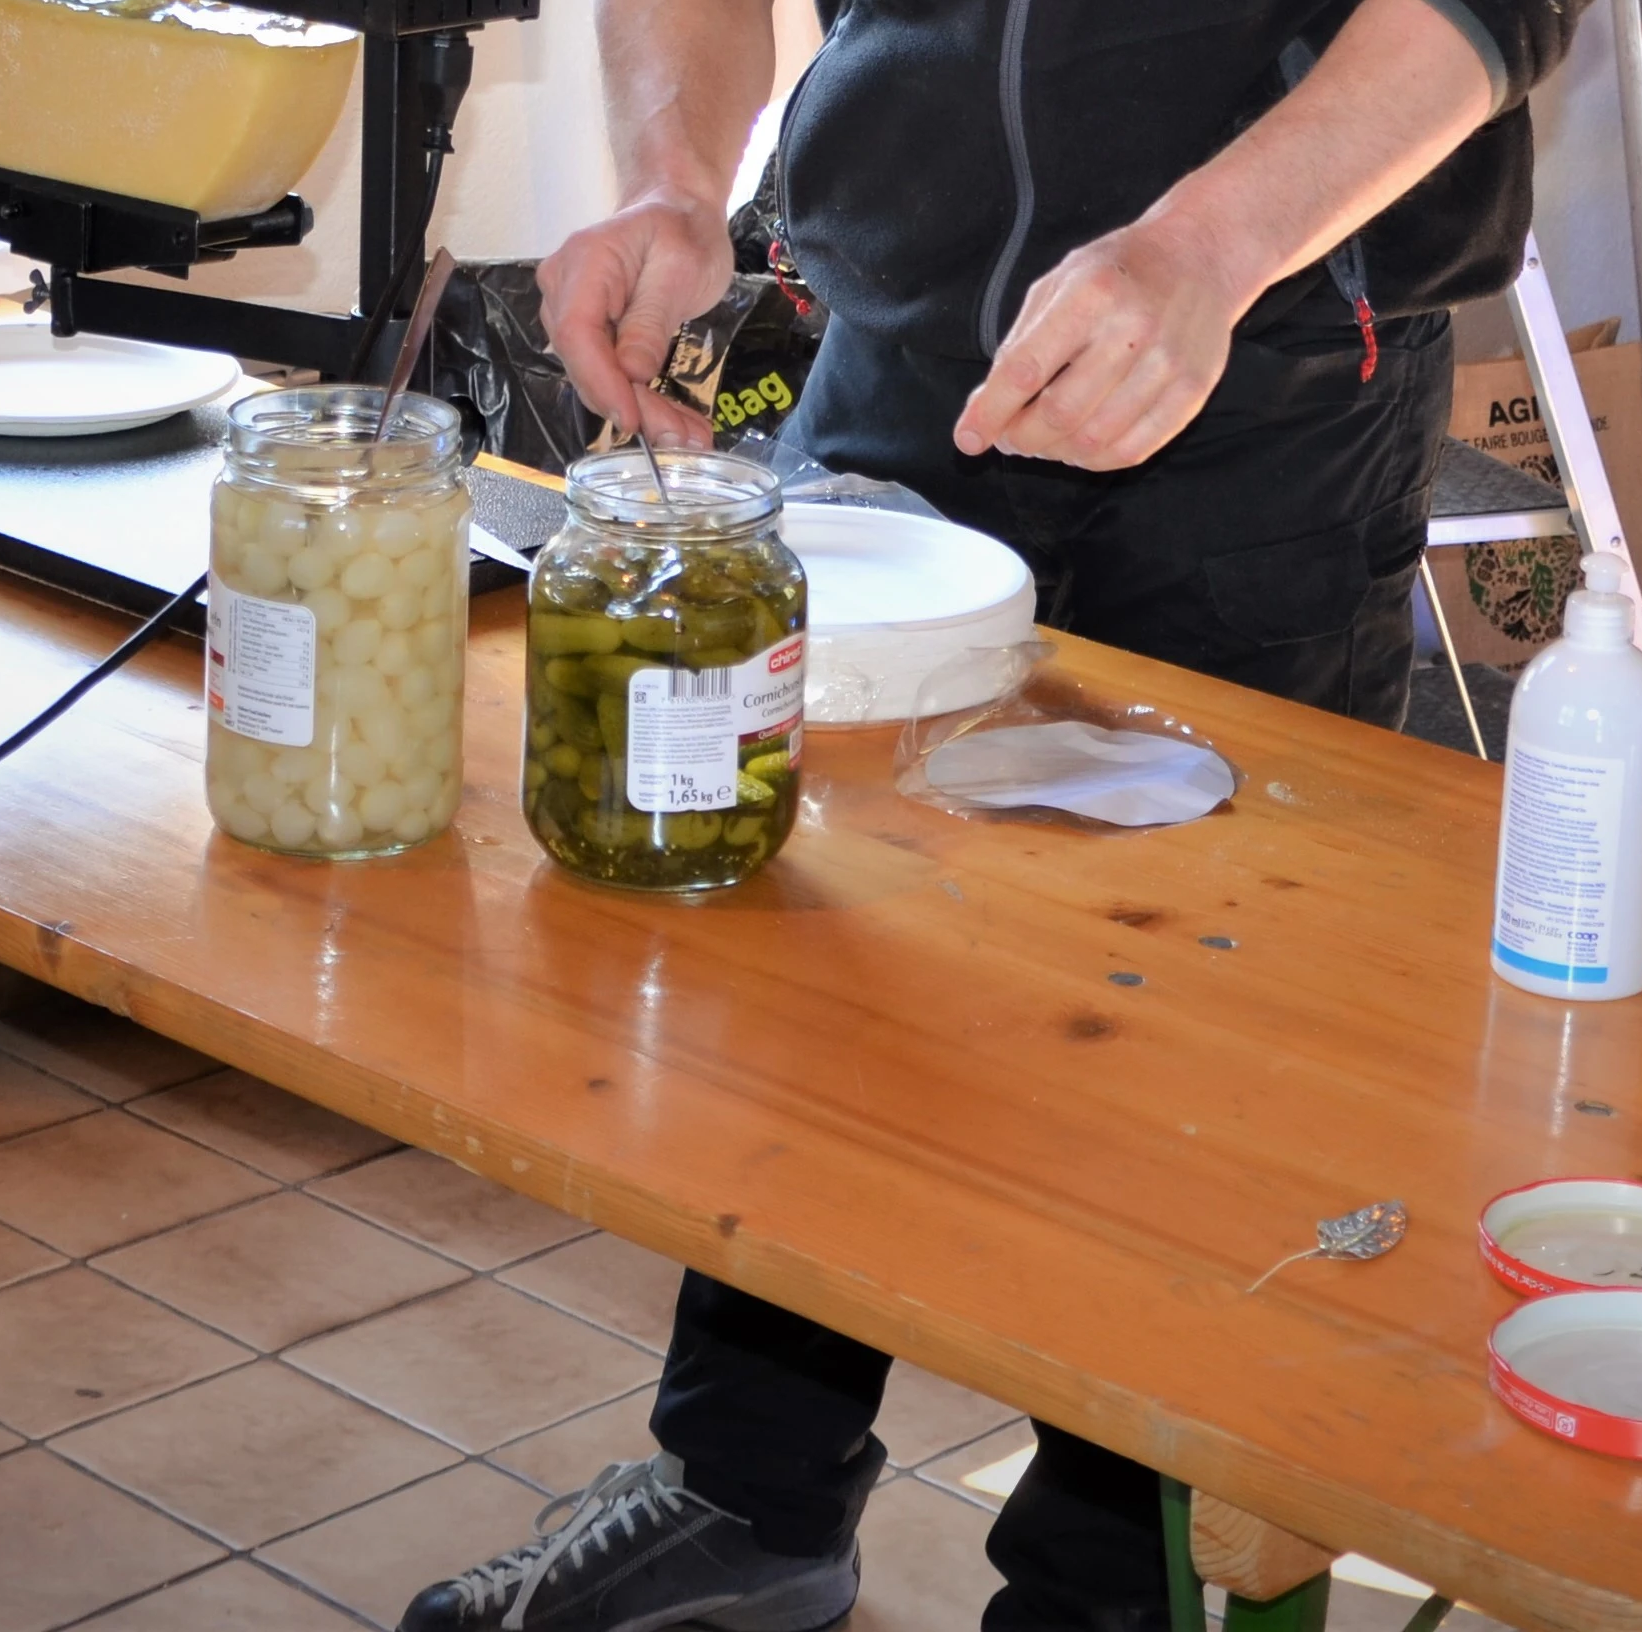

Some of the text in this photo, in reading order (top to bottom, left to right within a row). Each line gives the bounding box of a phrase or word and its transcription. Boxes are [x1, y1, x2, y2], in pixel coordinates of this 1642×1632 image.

[1488, 397, 1540, 428] AGI
[1473, 434, 1508, 452] FAIRE
[671, 773, 678, 786] 1
[680, 774, 694, 788] kg
[668, 789, 698, 806] 1,65
[700, 791, 713, 805] kg
